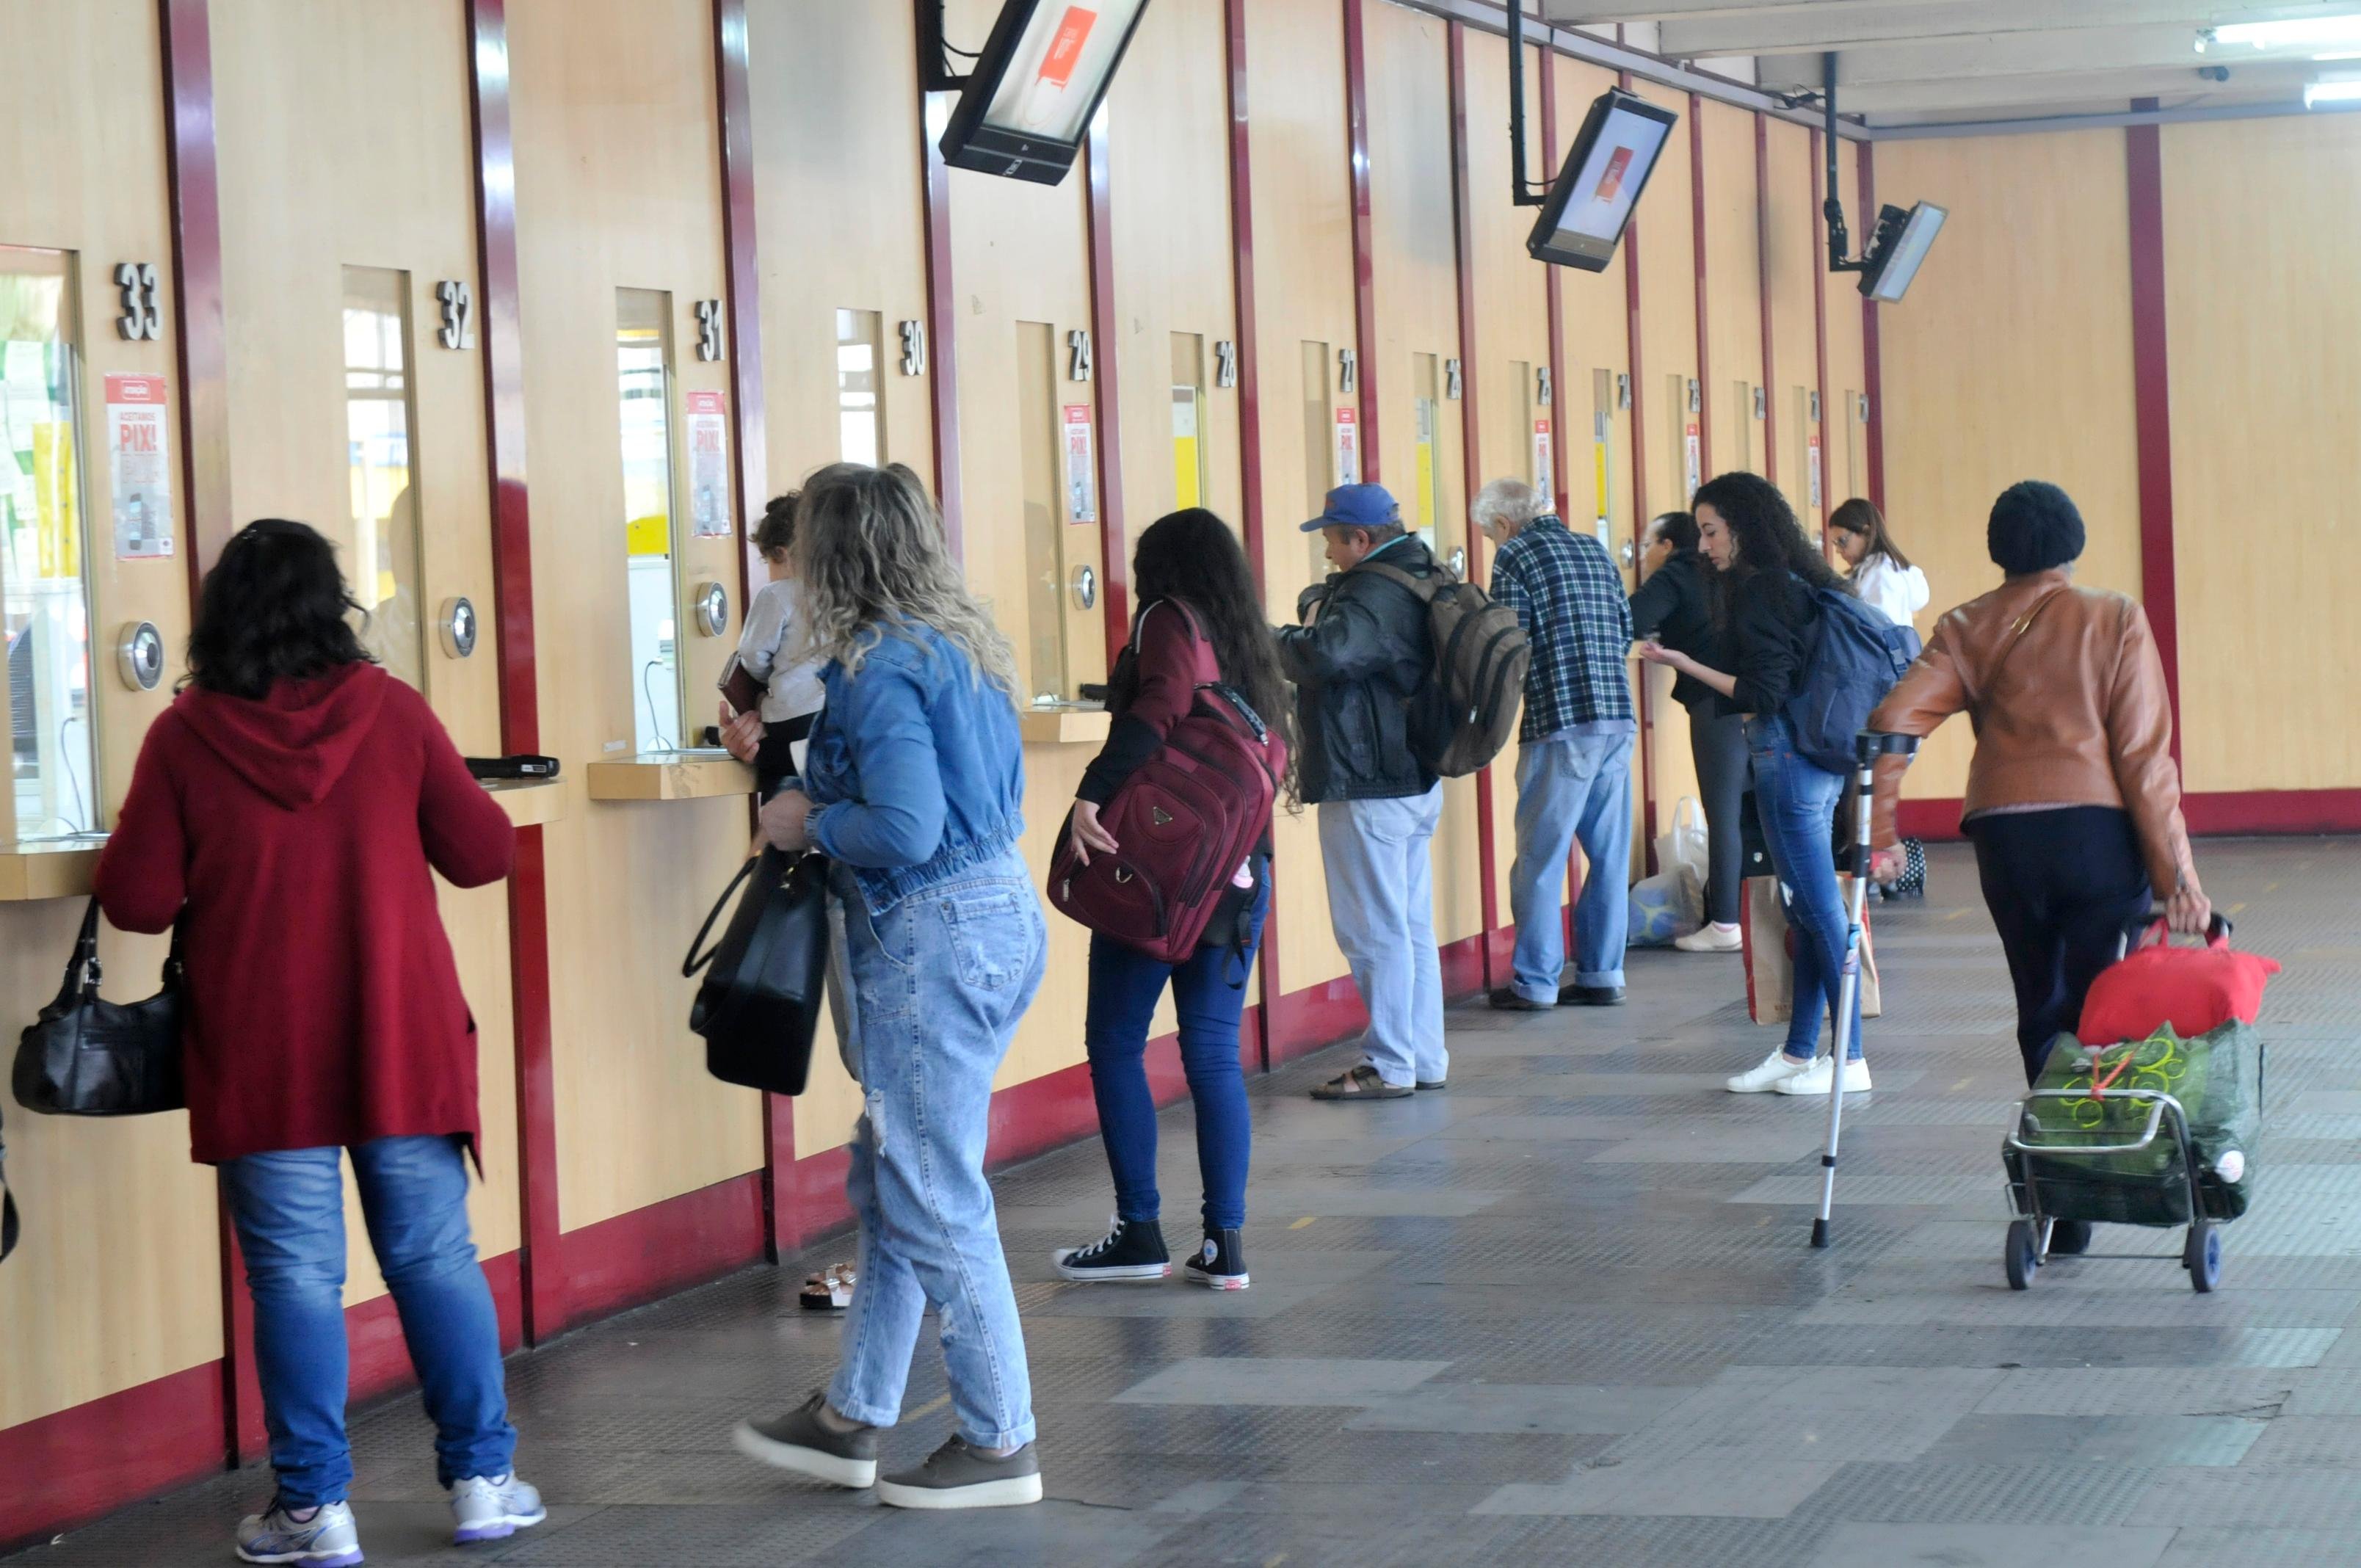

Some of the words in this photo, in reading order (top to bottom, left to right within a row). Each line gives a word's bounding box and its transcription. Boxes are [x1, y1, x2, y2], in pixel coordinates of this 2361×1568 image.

[114, 263, 163, 341] 33
[435, 281, 474, 349] 32
[694, 300, 725, 362] 31
[899, 320, 925, 375] 30
[1068, 330, 1092, 381] 29
[1216, 341, 1236, 388] 28
[1339, 349, 1355, 392] 27
[1445, 359, 1462, 399] 26
[120, 424, 157, 451] PIX!
